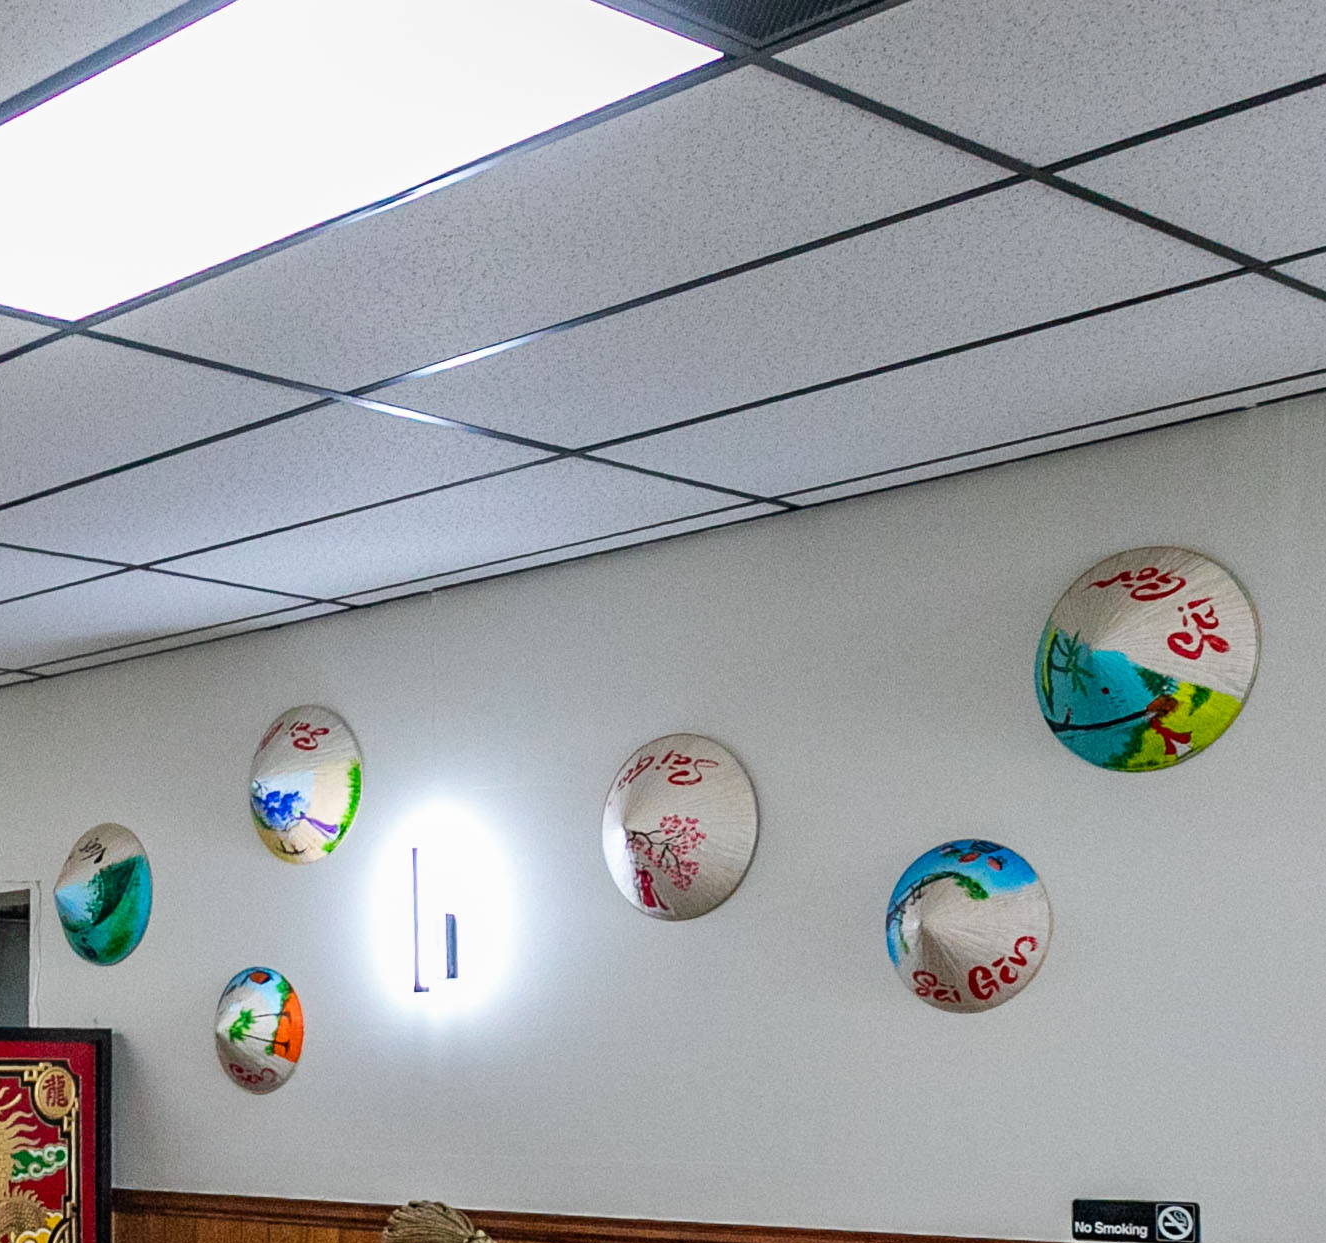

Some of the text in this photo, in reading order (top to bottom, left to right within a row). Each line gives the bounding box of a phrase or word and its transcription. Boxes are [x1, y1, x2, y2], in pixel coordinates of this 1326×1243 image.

[42, 1074, 69, 1108] 龍
[1074, 1221, 1148, 1239] No Smoking
